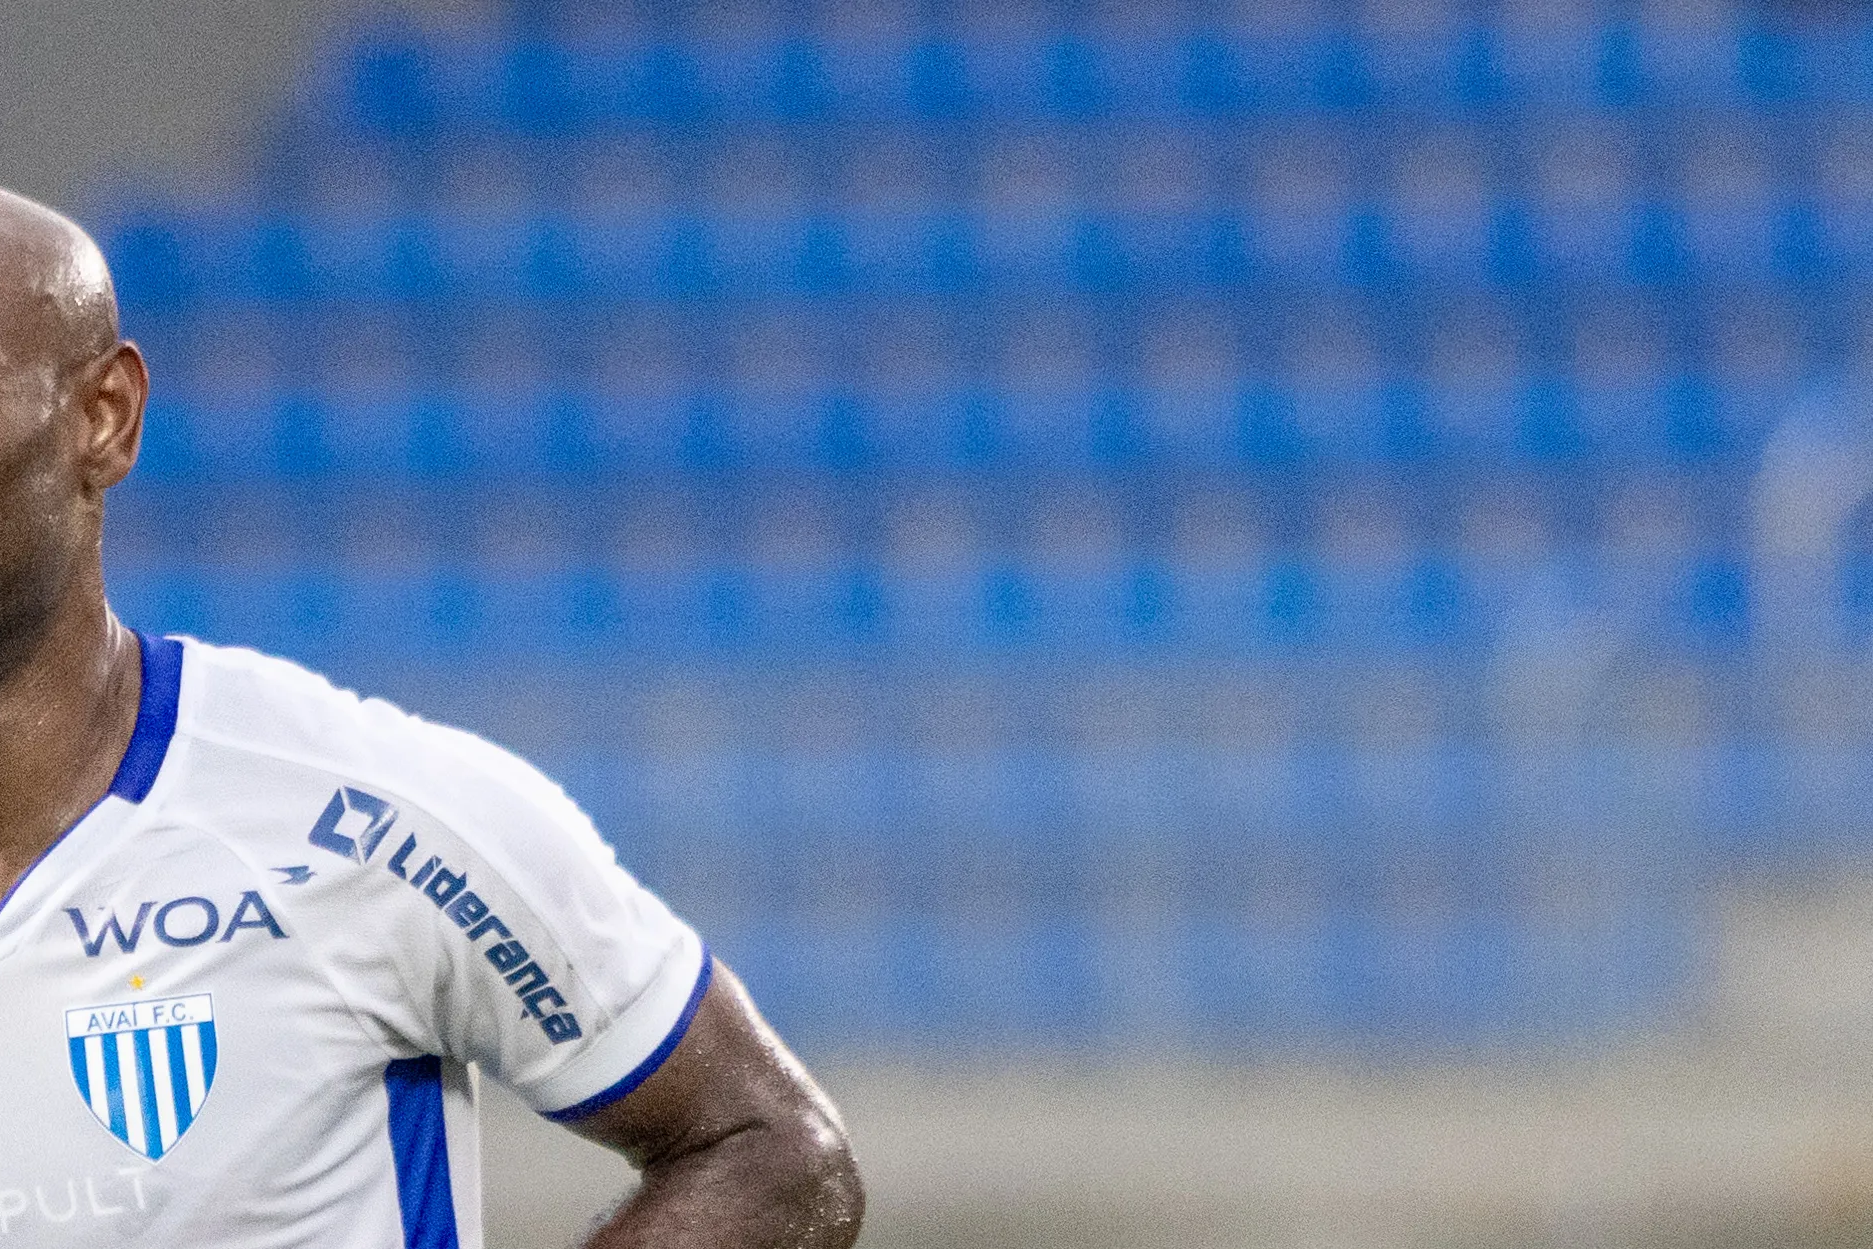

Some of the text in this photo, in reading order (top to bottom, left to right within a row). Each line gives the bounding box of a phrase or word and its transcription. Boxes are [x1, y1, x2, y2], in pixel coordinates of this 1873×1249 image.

[62, 890, 290, 957] WOA
[387, 832, 583, 1046] Liderança
[153, 1002, 194, 1024] F.C.
